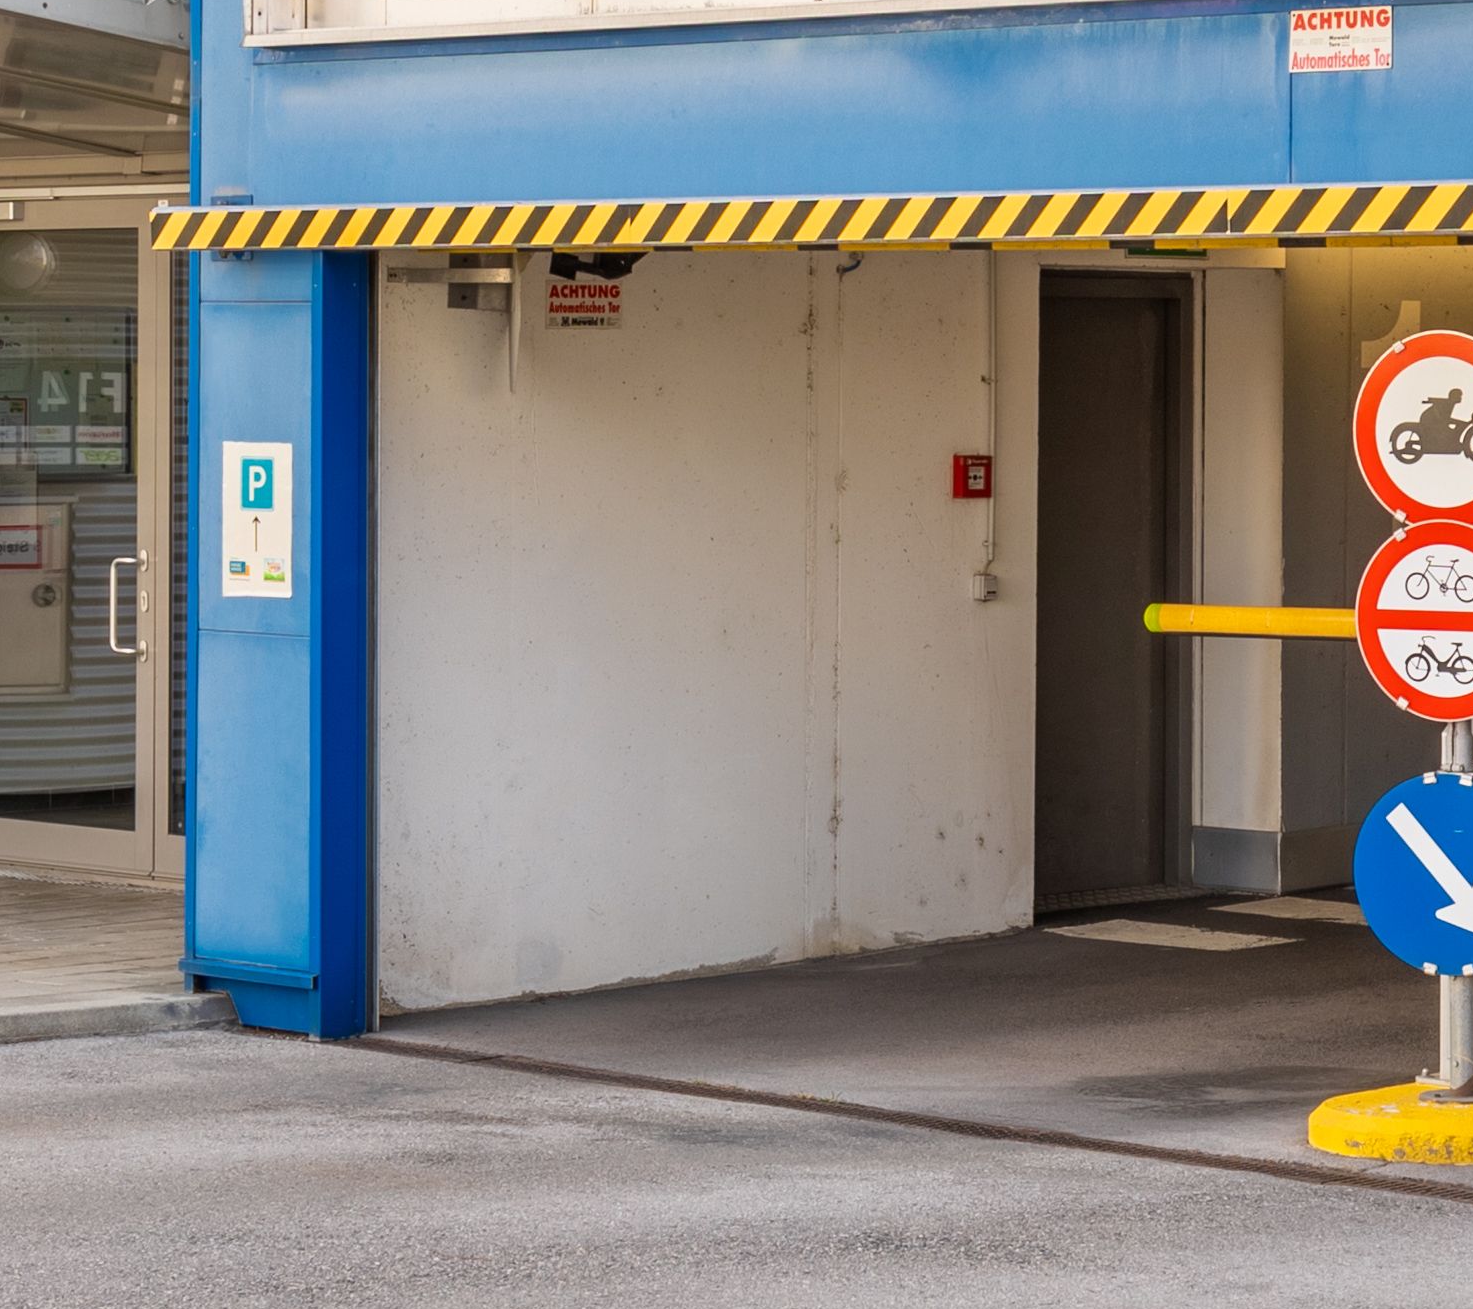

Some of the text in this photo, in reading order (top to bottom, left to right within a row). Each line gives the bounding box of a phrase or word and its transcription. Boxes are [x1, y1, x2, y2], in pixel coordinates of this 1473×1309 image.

[1292, 8, 1391, 31] ACHTUNG
[1292, 47, 1391, 70] Automatisches Tor
[549, 284, 621, 299] ACHTUNG
[549, 301, 621, 314] Automatisches Tor
[248, 465, 267, 502] P
